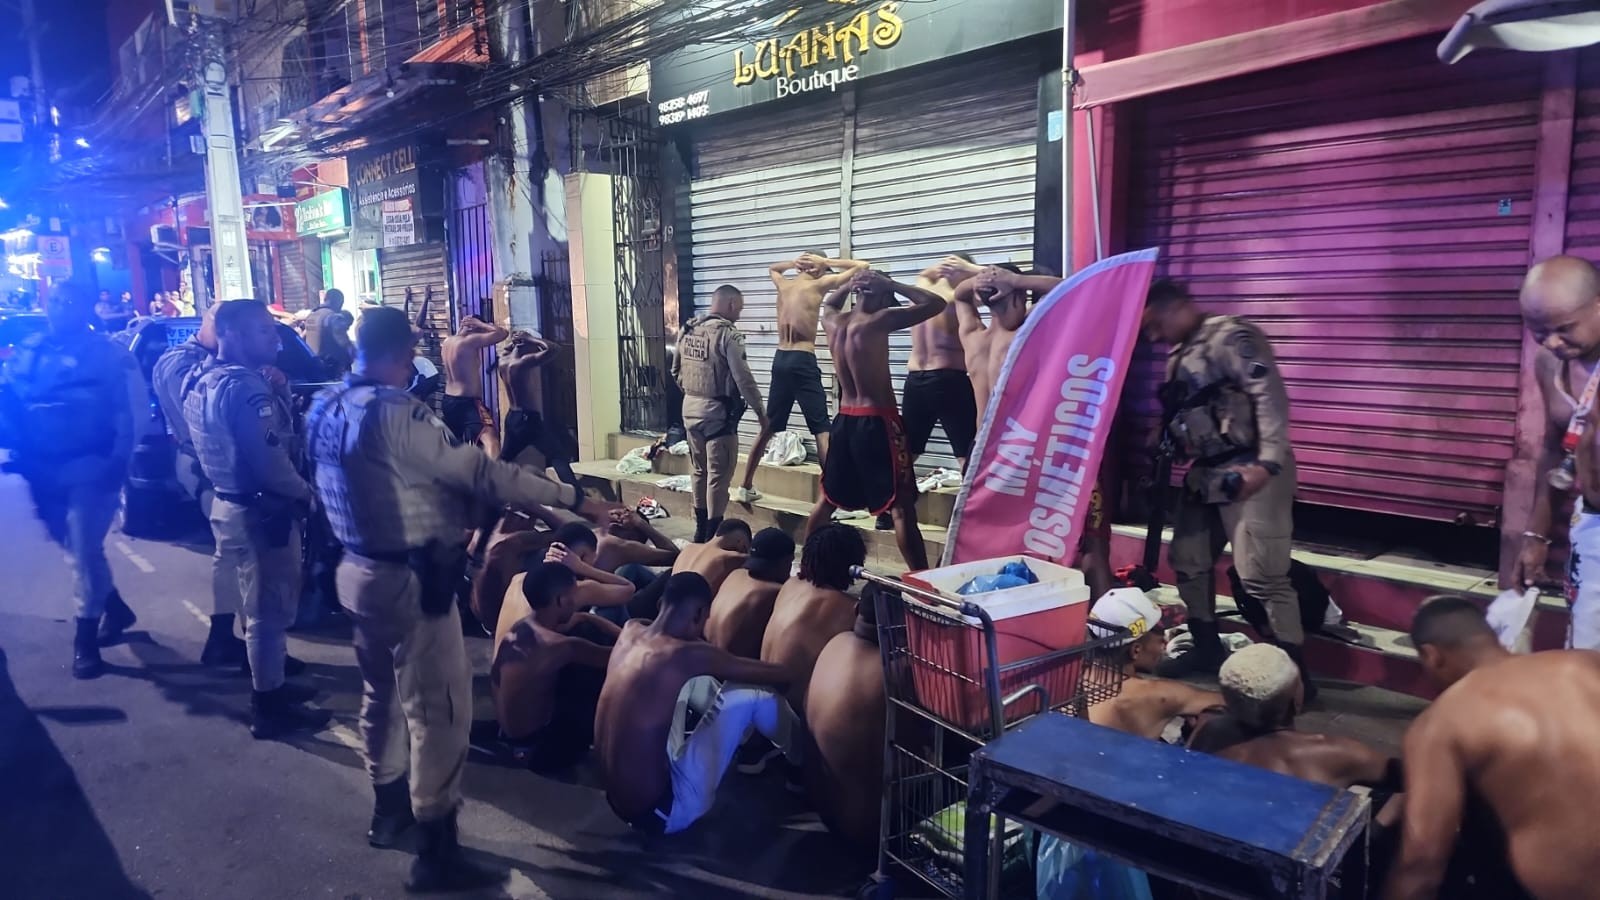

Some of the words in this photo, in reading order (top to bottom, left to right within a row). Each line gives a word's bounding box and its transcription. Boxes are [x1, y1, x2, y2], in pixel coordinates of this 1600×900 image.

[733, 2, 903, 87] LUANAS
[777, 65, 860, 98] Boutique
[356, 152, 391, 185] CONNECT
[393, 146, 416, 174] CELL
[684, 347, 705, 359] MILITAR
[984, 417, 1038, 497] MAY
[1023, 353, 1116, 559] OSMÉTICOS
